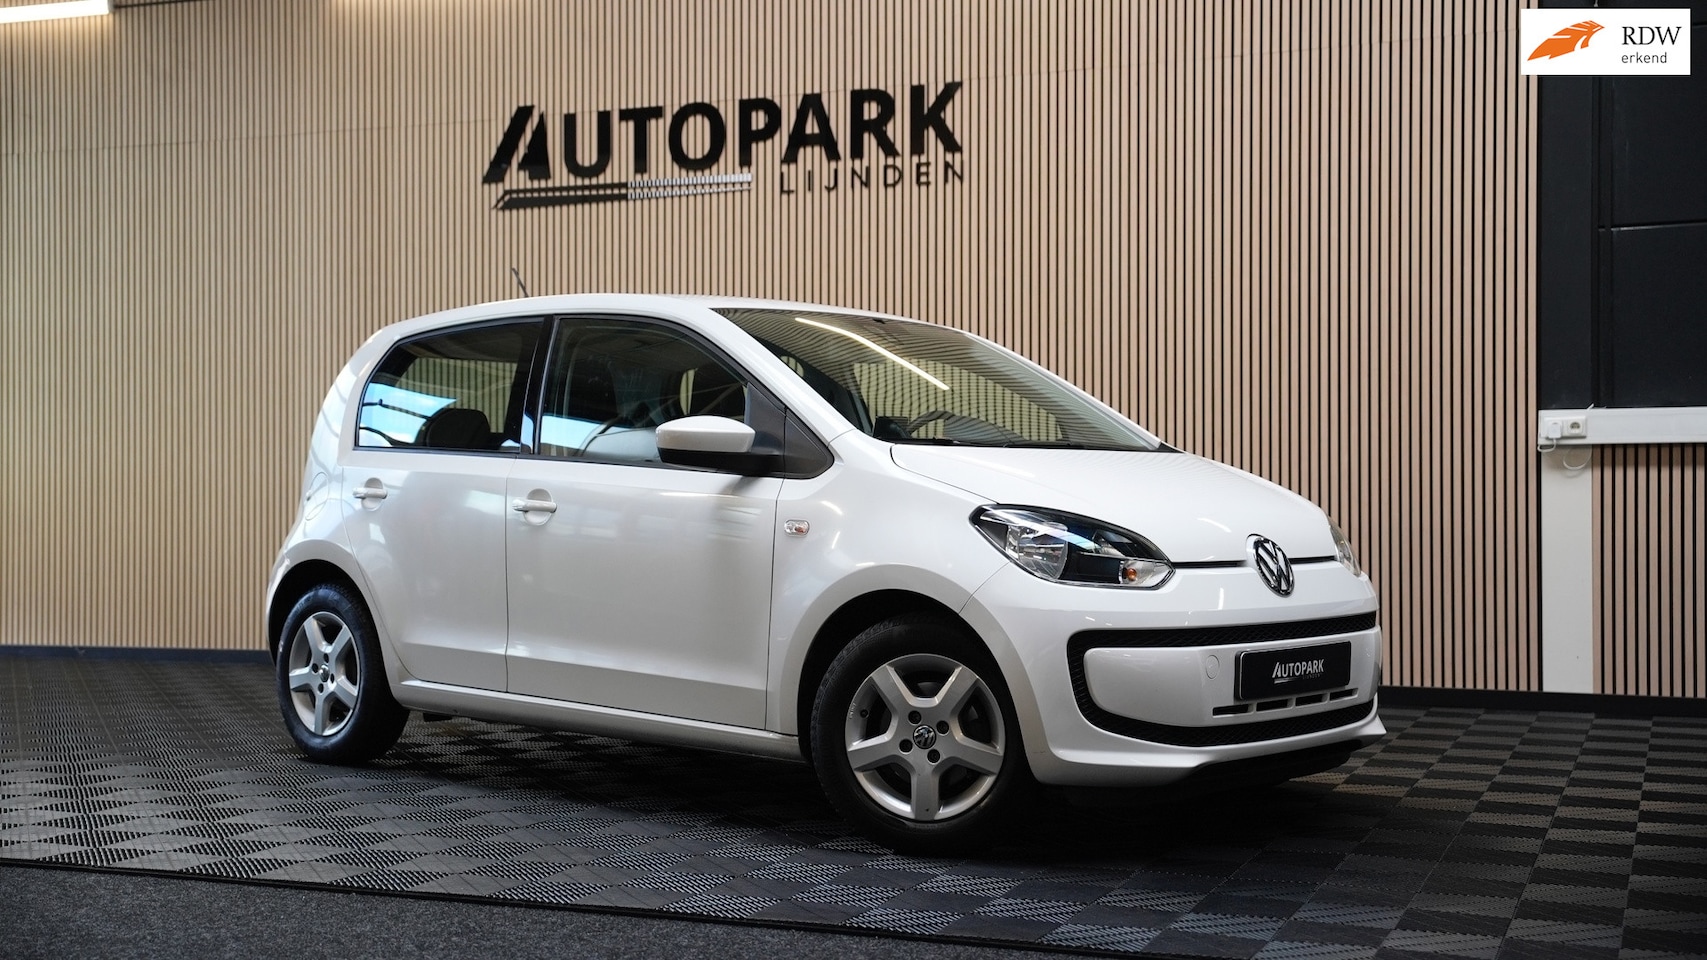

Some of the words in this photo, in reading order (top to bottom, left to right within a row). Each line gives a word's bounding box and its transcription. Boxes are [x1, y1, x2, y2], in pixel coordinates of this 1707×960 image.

[482, 81, 963, 184] AUTOPARK
[779, 160, 965, 195] LIJNDEN
[1272, 658, 1325, 679] AUTOPARK
